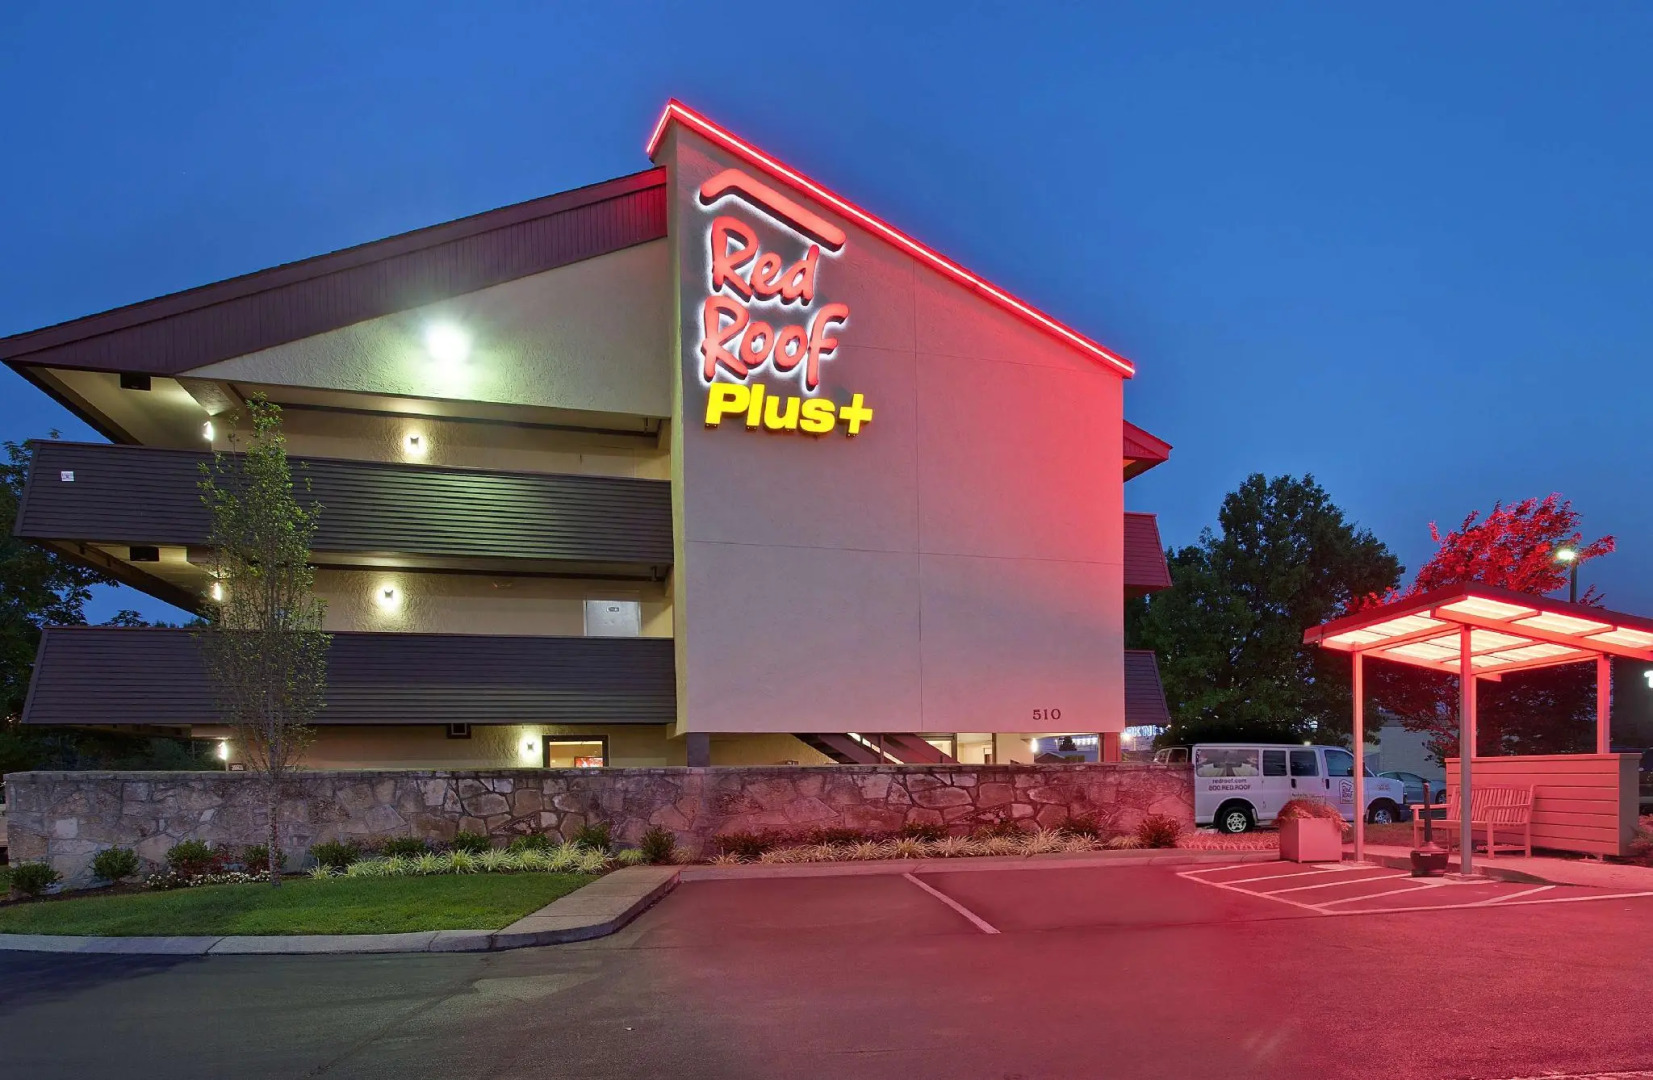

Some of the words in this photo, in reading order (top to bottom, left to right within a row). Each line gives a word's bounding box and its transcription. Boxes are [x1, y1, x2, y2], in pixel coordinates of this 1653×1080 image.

[711, 216, 820, 306] Red
[701, 295, 849, 391] Roof
[705, 382, 873, 435] Plus+
[1032, 708, 1061, 720] 510
